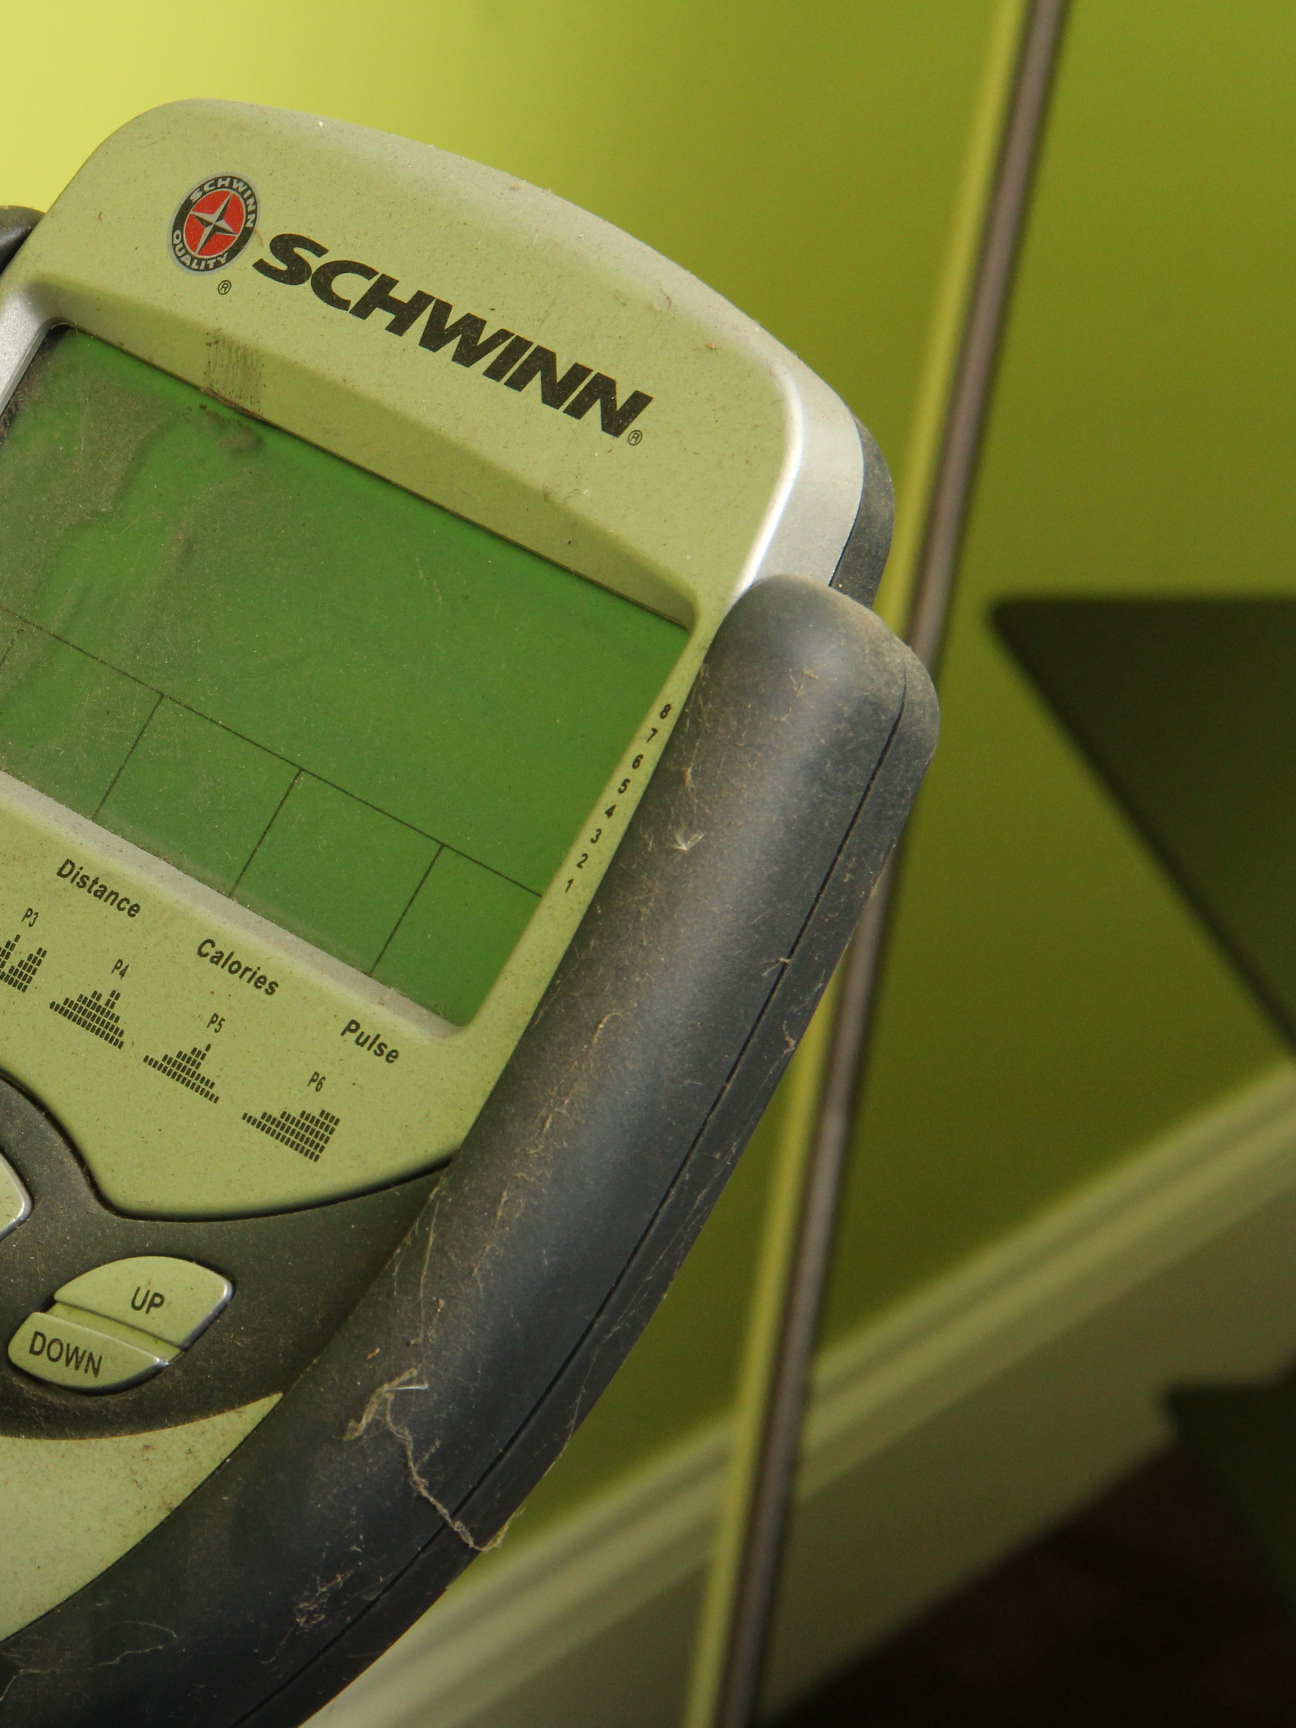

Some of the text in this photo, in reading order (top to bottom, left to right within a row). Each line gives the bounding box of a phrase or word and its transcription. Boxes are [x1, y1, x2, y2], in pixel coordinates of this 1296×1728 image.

[189, 177, 257, 228] SCHWINN
[172, 229, 229, 270] QUALITY
[251, 233, 654, 438] SCHWINN
[659, 703, 672, 719] 8
[646, 728, 659, 743] 7
[632, 754, 644, 770] 6
[618, 778, 630, 794] 5
[605, 804, 616, 819] 4
[590, 828, 602, 844] 3
[576, 853, 589, 869] 2
[56, 858, 142, 919] Distance
[565, 878, 574, 893] 1
[21, 907, 40, 928] P3
[111, 958, 130, 980] P4
[197, 938, 280, 997] Calories
[206, 1012, 226, 1035] P5
[340, 1018, 401, 1065] Pulse
[307, 1071, 326, 1093] P6
[130, 1286, 165, 1315] UP
[28, 1330, 103, 1378] DOWN
